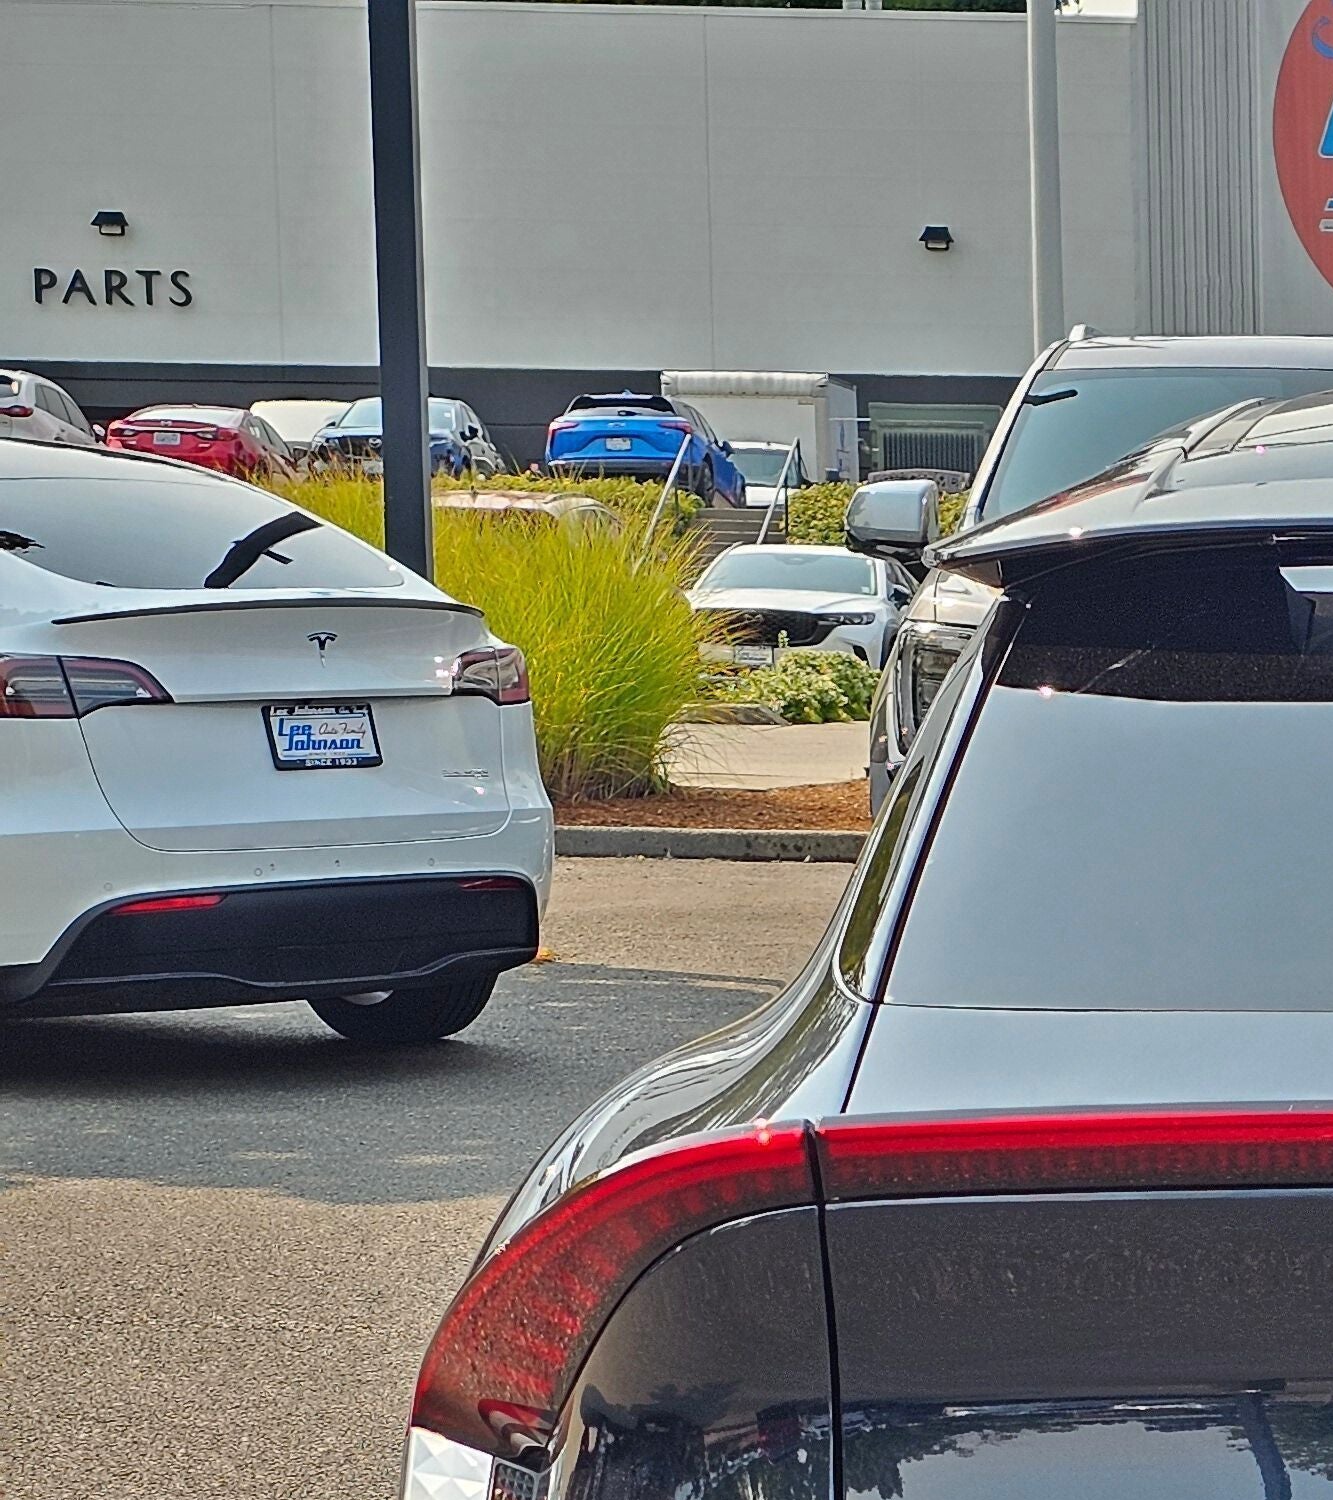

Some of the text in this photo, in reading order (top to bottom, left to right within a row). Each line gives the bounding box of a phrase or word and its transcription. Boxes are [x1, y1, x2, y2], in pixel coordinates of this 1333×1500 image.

[33, 267, 193, 307] PARTS
[277, 717, 316, 737] Lee
[282, 732, 365, 752] Johnson
